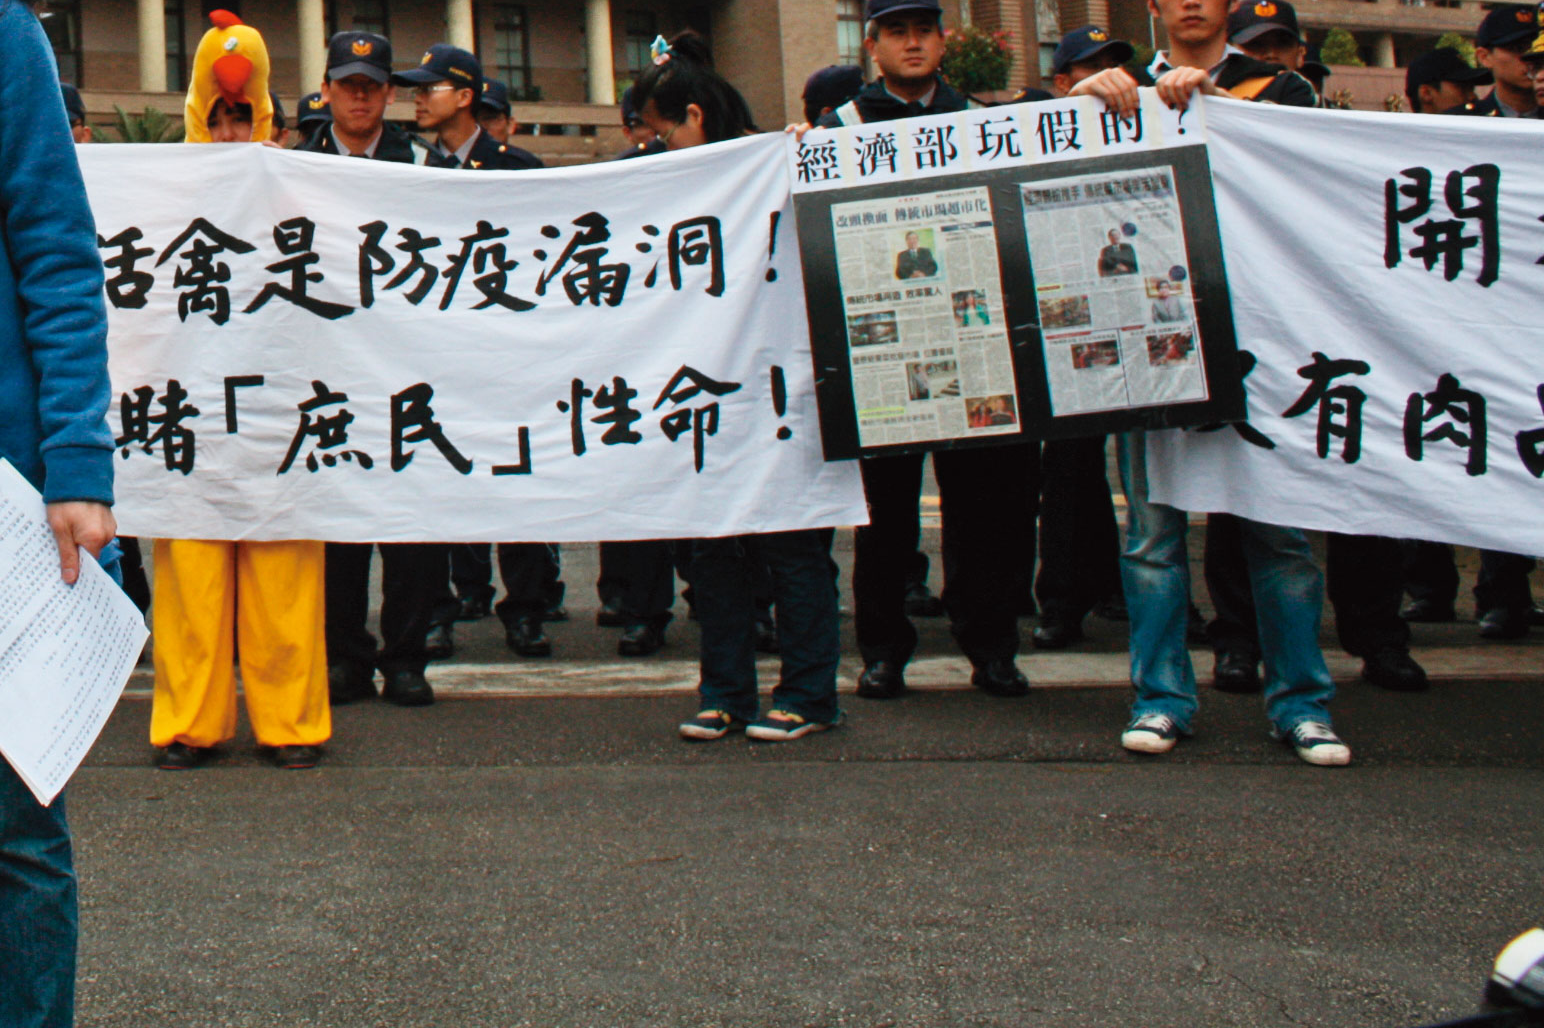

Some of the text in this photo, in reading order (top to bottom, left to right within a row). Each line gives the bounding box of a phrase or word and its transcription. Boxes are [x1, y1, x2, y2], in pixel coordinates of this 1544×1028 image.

[1383, 162, 1544, 289] 開
[114, 364, 793, 477] 賭「庶民」性命！
[1180, 348, 1544, 481] 有肉
